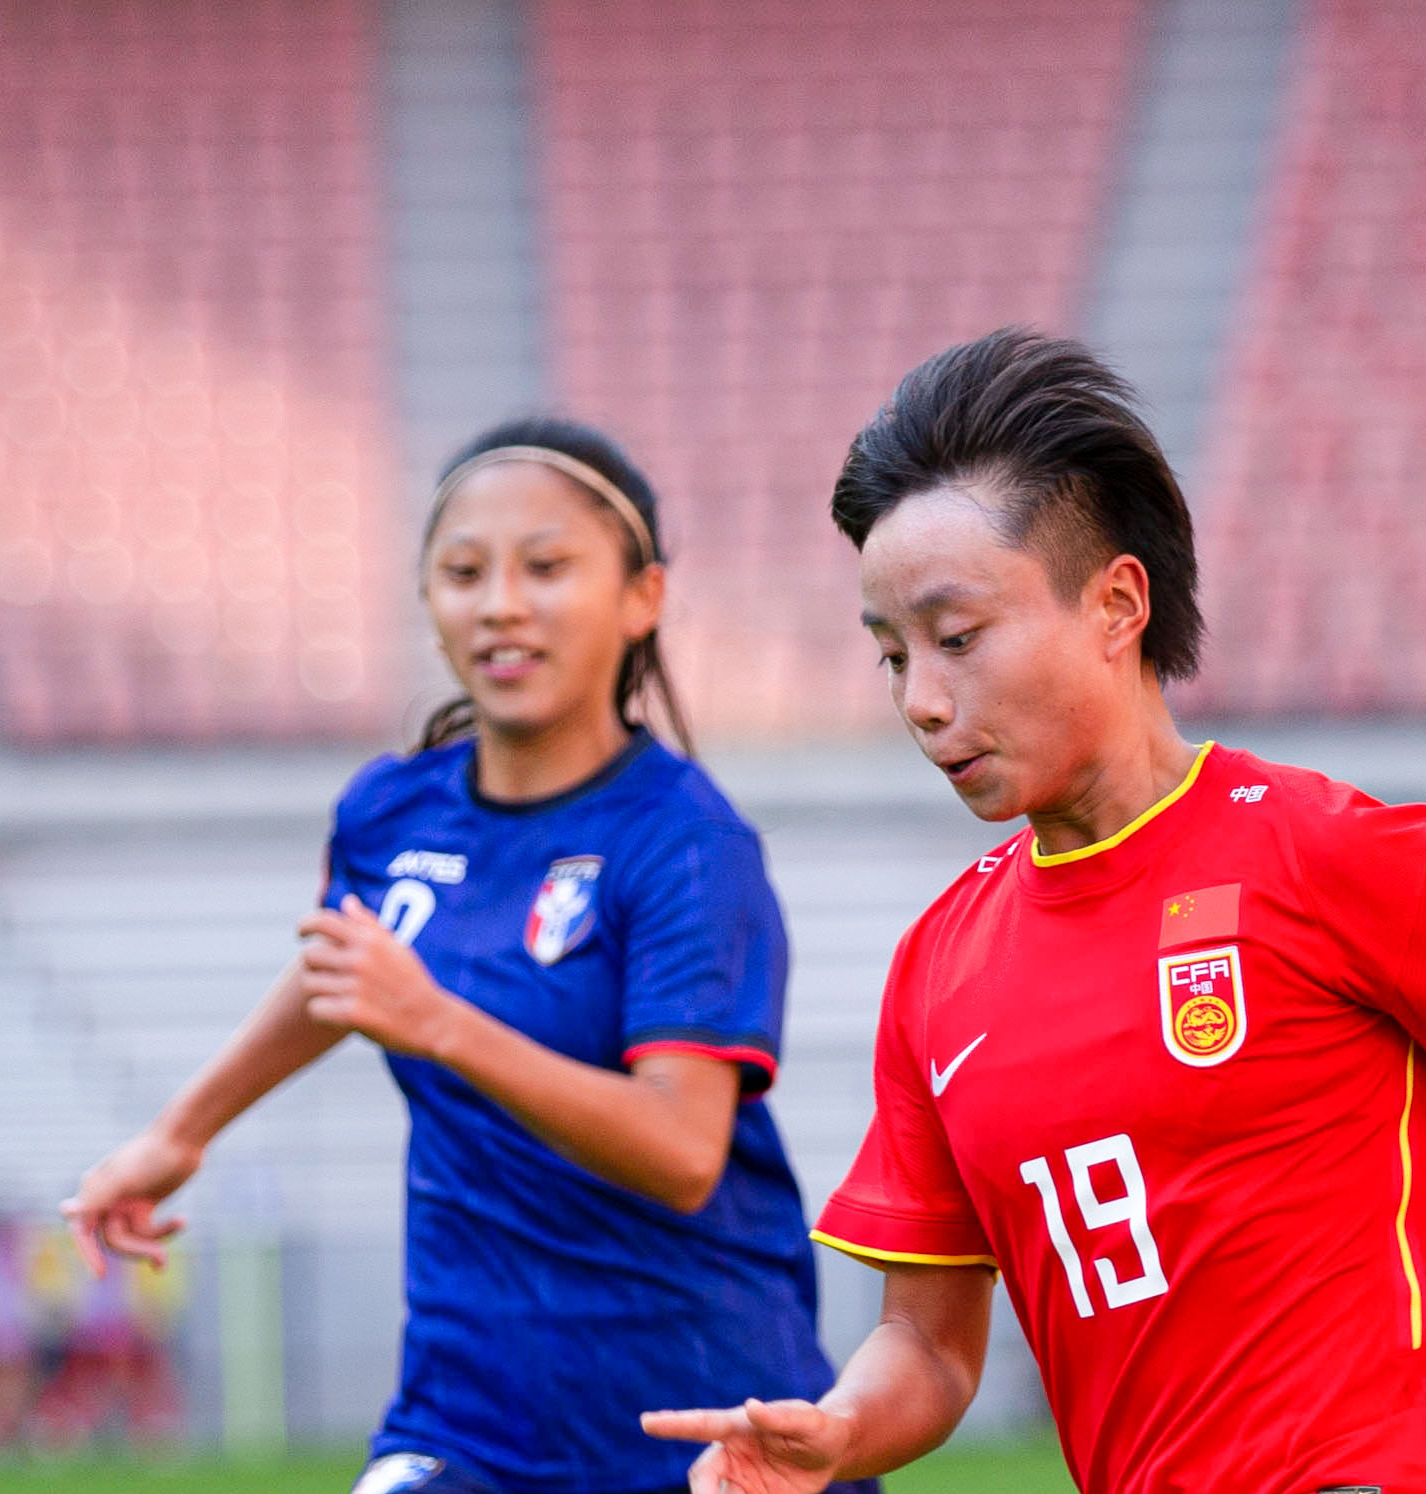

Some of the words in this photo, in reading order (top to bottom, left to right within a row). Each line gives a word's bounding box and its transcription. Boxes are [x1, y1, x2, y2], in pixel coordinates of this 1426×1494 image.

[1229, 784, 1269, 803] 中国
[1170, 959, 1230, 986] CFA
[1189, 980, 1214, 995] 中国
[1019, 1133, 1169, 1319] 19
